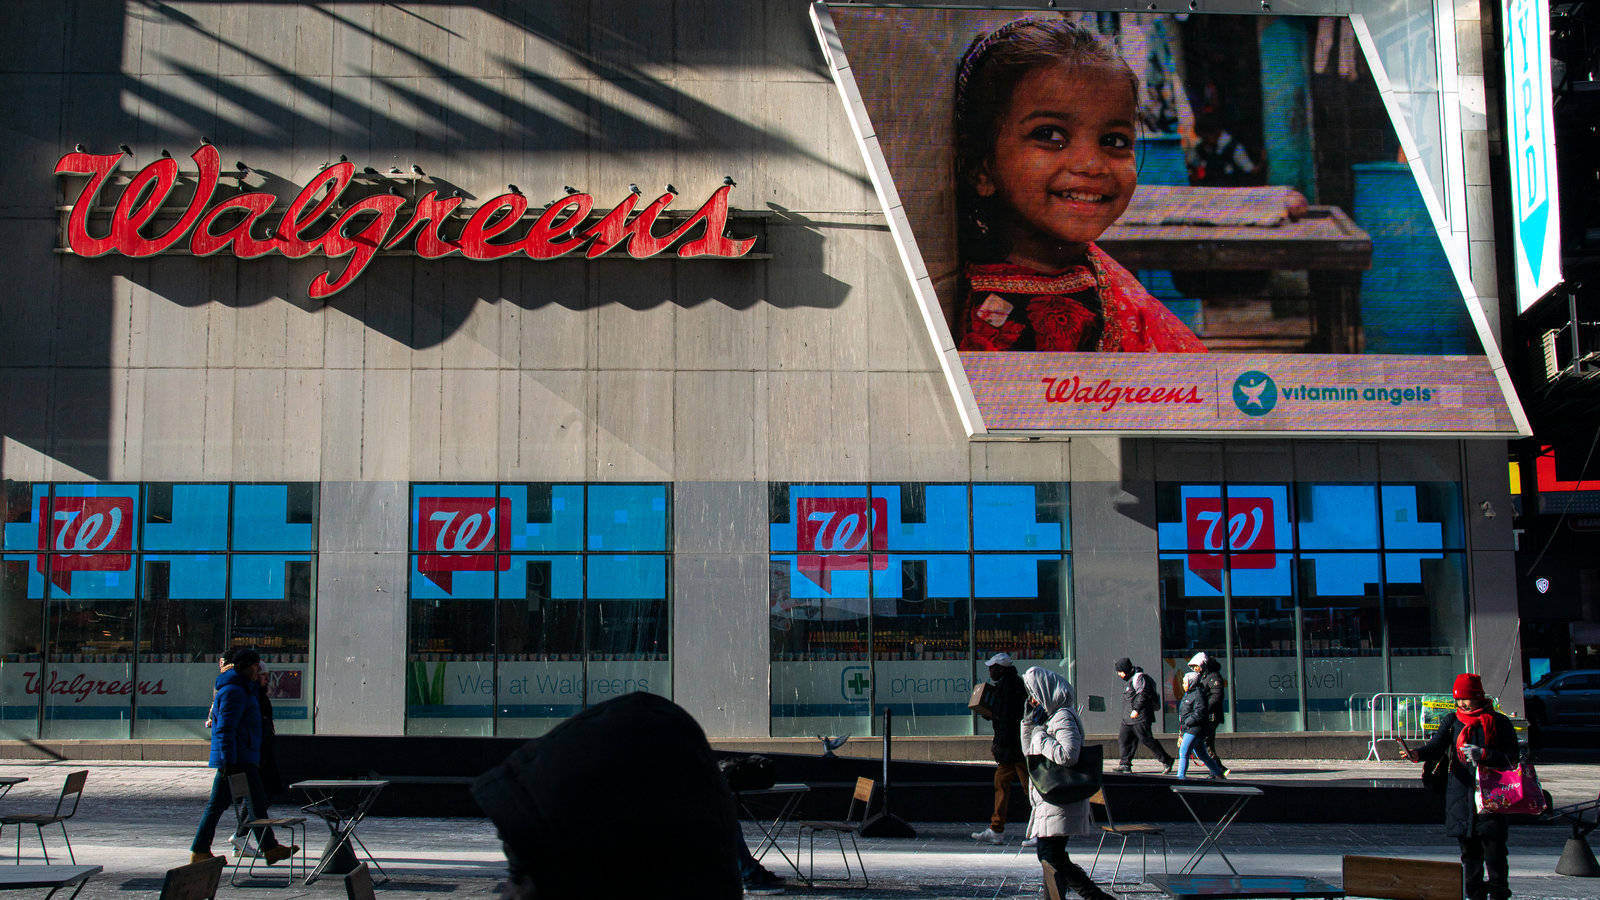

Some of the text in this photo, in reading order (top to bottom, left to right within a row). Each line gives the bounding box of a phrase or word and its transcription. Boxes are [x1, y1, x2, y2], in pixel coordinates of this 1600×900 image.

[1517, 0, 1536, 208] YPD
[55, 144, 758, 299] Walgreens
[1041, 376, 1203, 412] Walgreens
[1281, 385, 1431, 406] vitamin angels
[23, 671, 168, 703] Walgreens
[458, 674, 649, 698] Wel at Walgreens
[891, 673, 982, 697] pharmac
[1268, 670, 1344, 689] eat well
